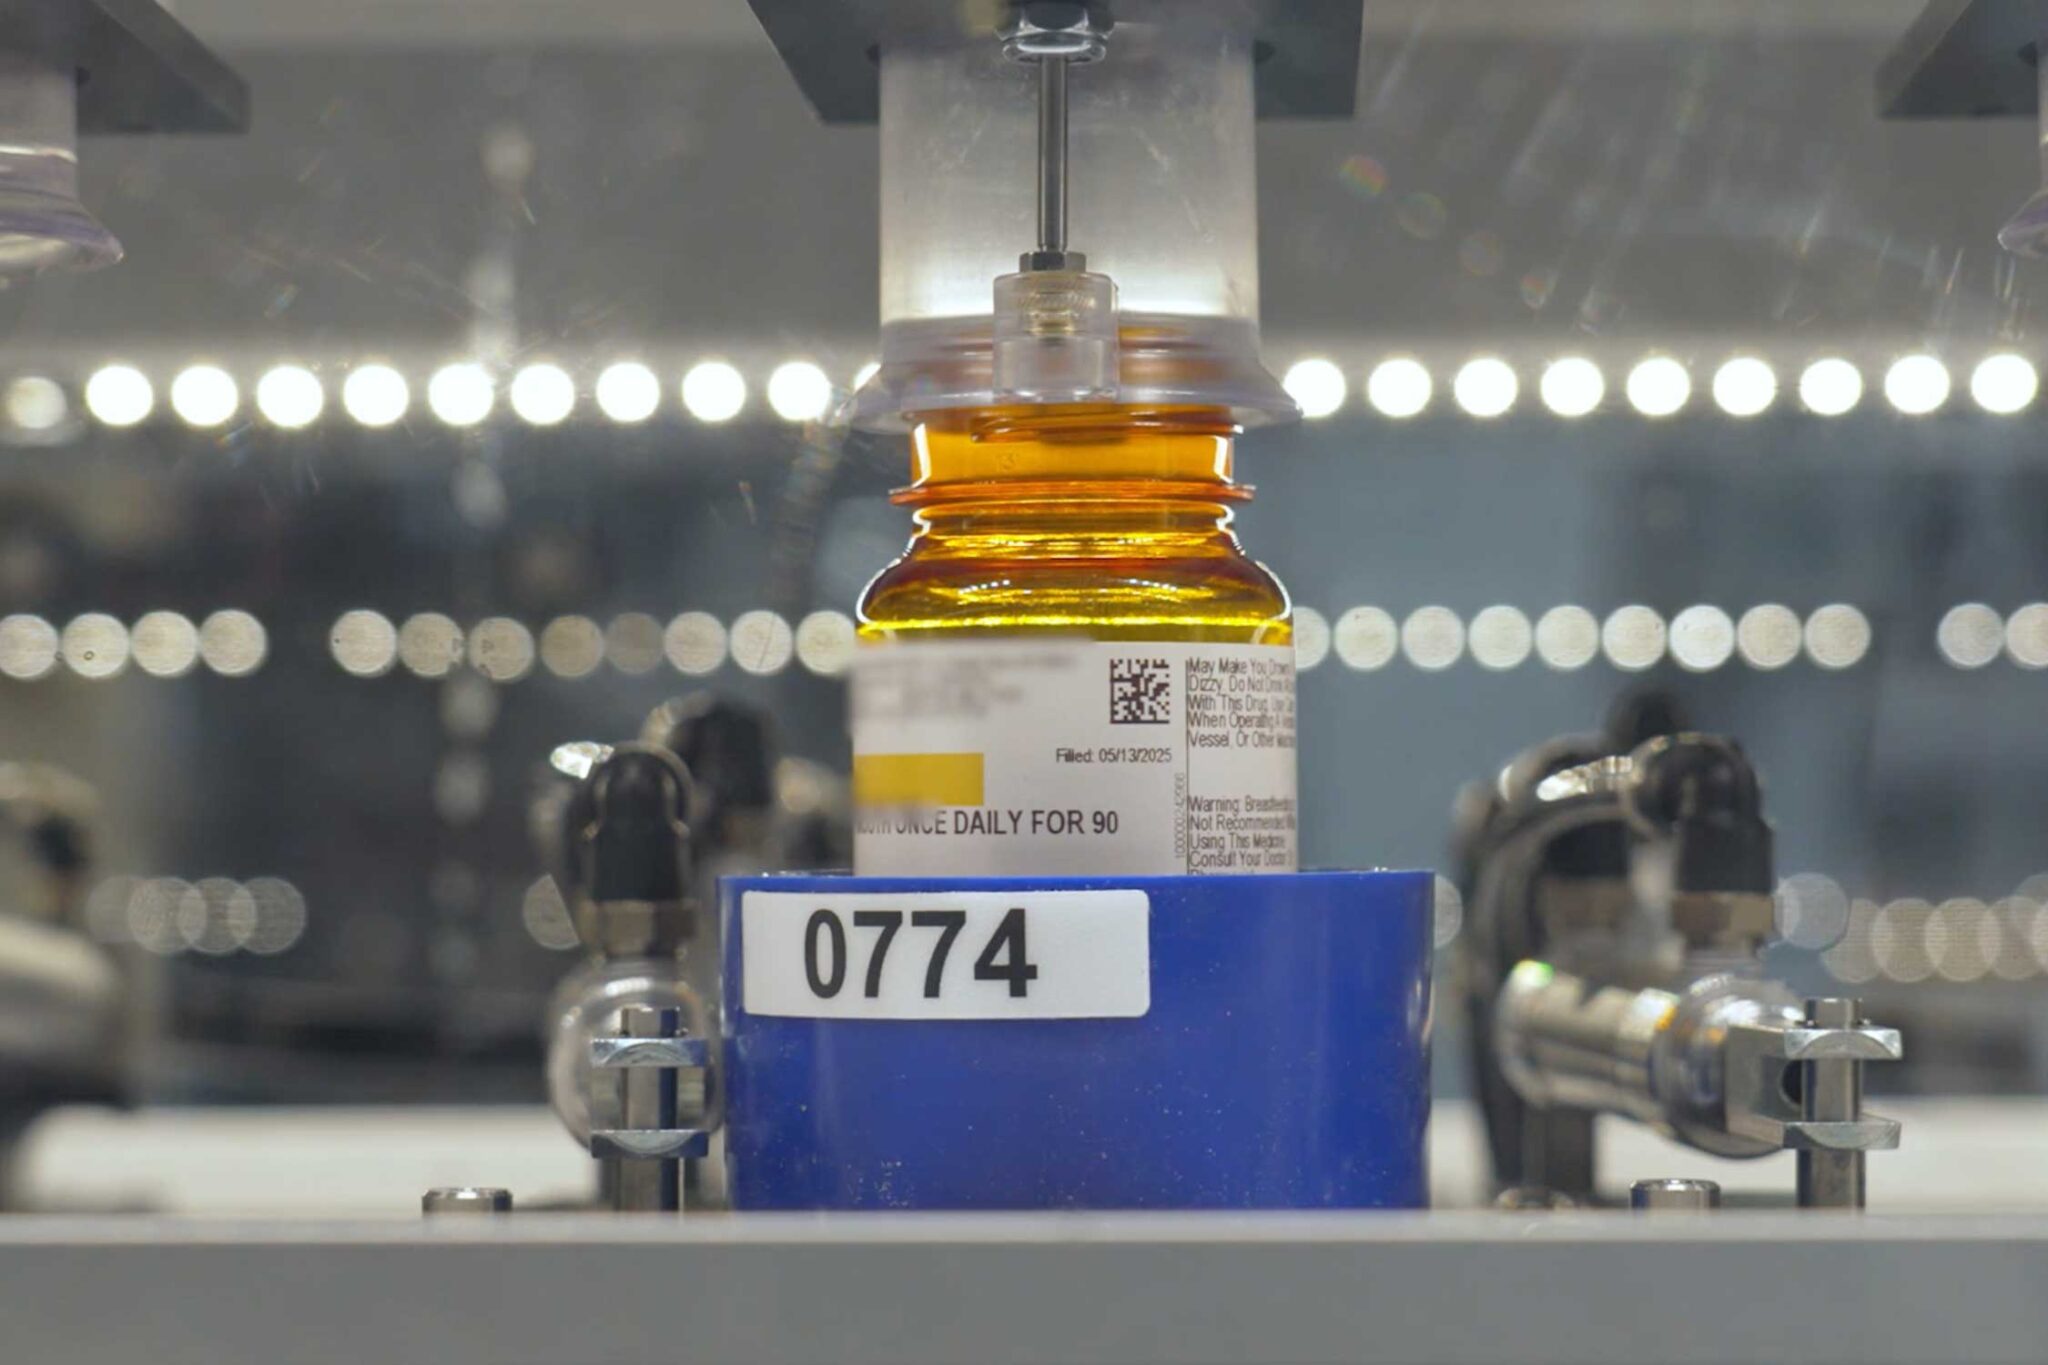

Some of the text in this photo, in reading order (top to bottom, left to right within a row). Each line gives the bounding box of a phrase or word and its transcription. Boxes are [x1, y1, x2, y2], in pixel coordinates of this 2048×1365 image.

[1189, 657, 1215, 677] May
[1219, 657, 1246, 674] Make
[1250, 657, 1266, 675] You
[1230, 675, 1245, 692] Do
[1188, 693, 1215, 710] With
[1222, 694, 1243, 711] This
[1188, 711, 1226, 728] When
[1236, 730, 1248, 748] Or
[1056, 748, 1172, 763] Filled: 05/13/2025
[954, 810, 1023, 835] DAILY
[1032, 810, 1084, 835] FOR
[1092, 810, 1118, 835] 90
[1190, 814, 1212, 830] Not
[1190, 832, 1225, 851] Using
[1229, 832, 1250, 849] This
[1190, 850, 1236, 867] Consult
[1239, 850, 1261, 866] Your
[804, 908, 1039, 999] 0774
